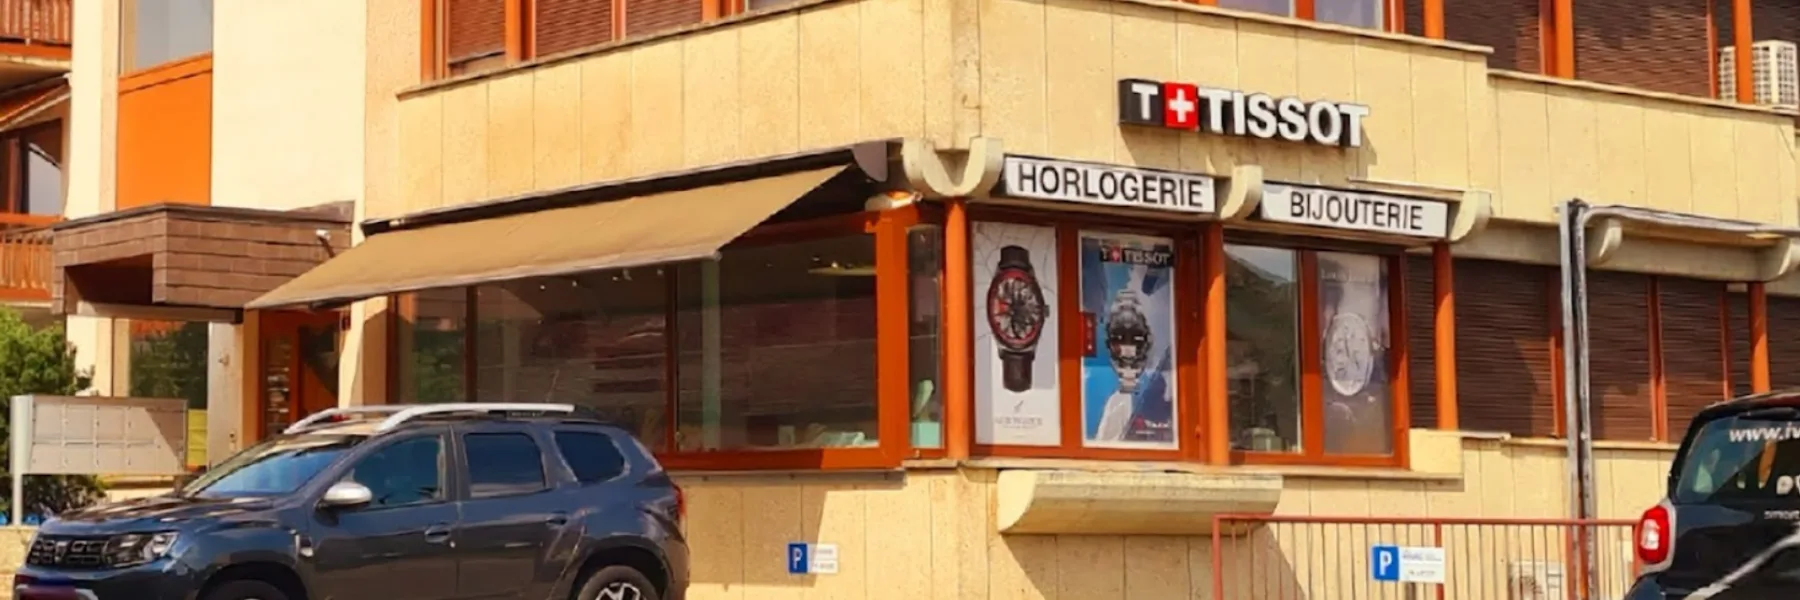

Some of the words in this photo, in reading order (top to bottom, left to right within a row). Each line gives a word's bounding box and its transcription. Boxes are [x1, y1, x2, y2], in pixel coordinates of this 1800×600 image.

[1198, 87, 1370, 148] TISSOT
[1017, 162, 1204, 208] HORLOGERIE
[1290, 190, 1423, 231] BIJOUTERIE
[1124, 249, 1171, 266] TISSOT
[792, 546, 803, 571] P
[1379, 550, 1393, 576] P
